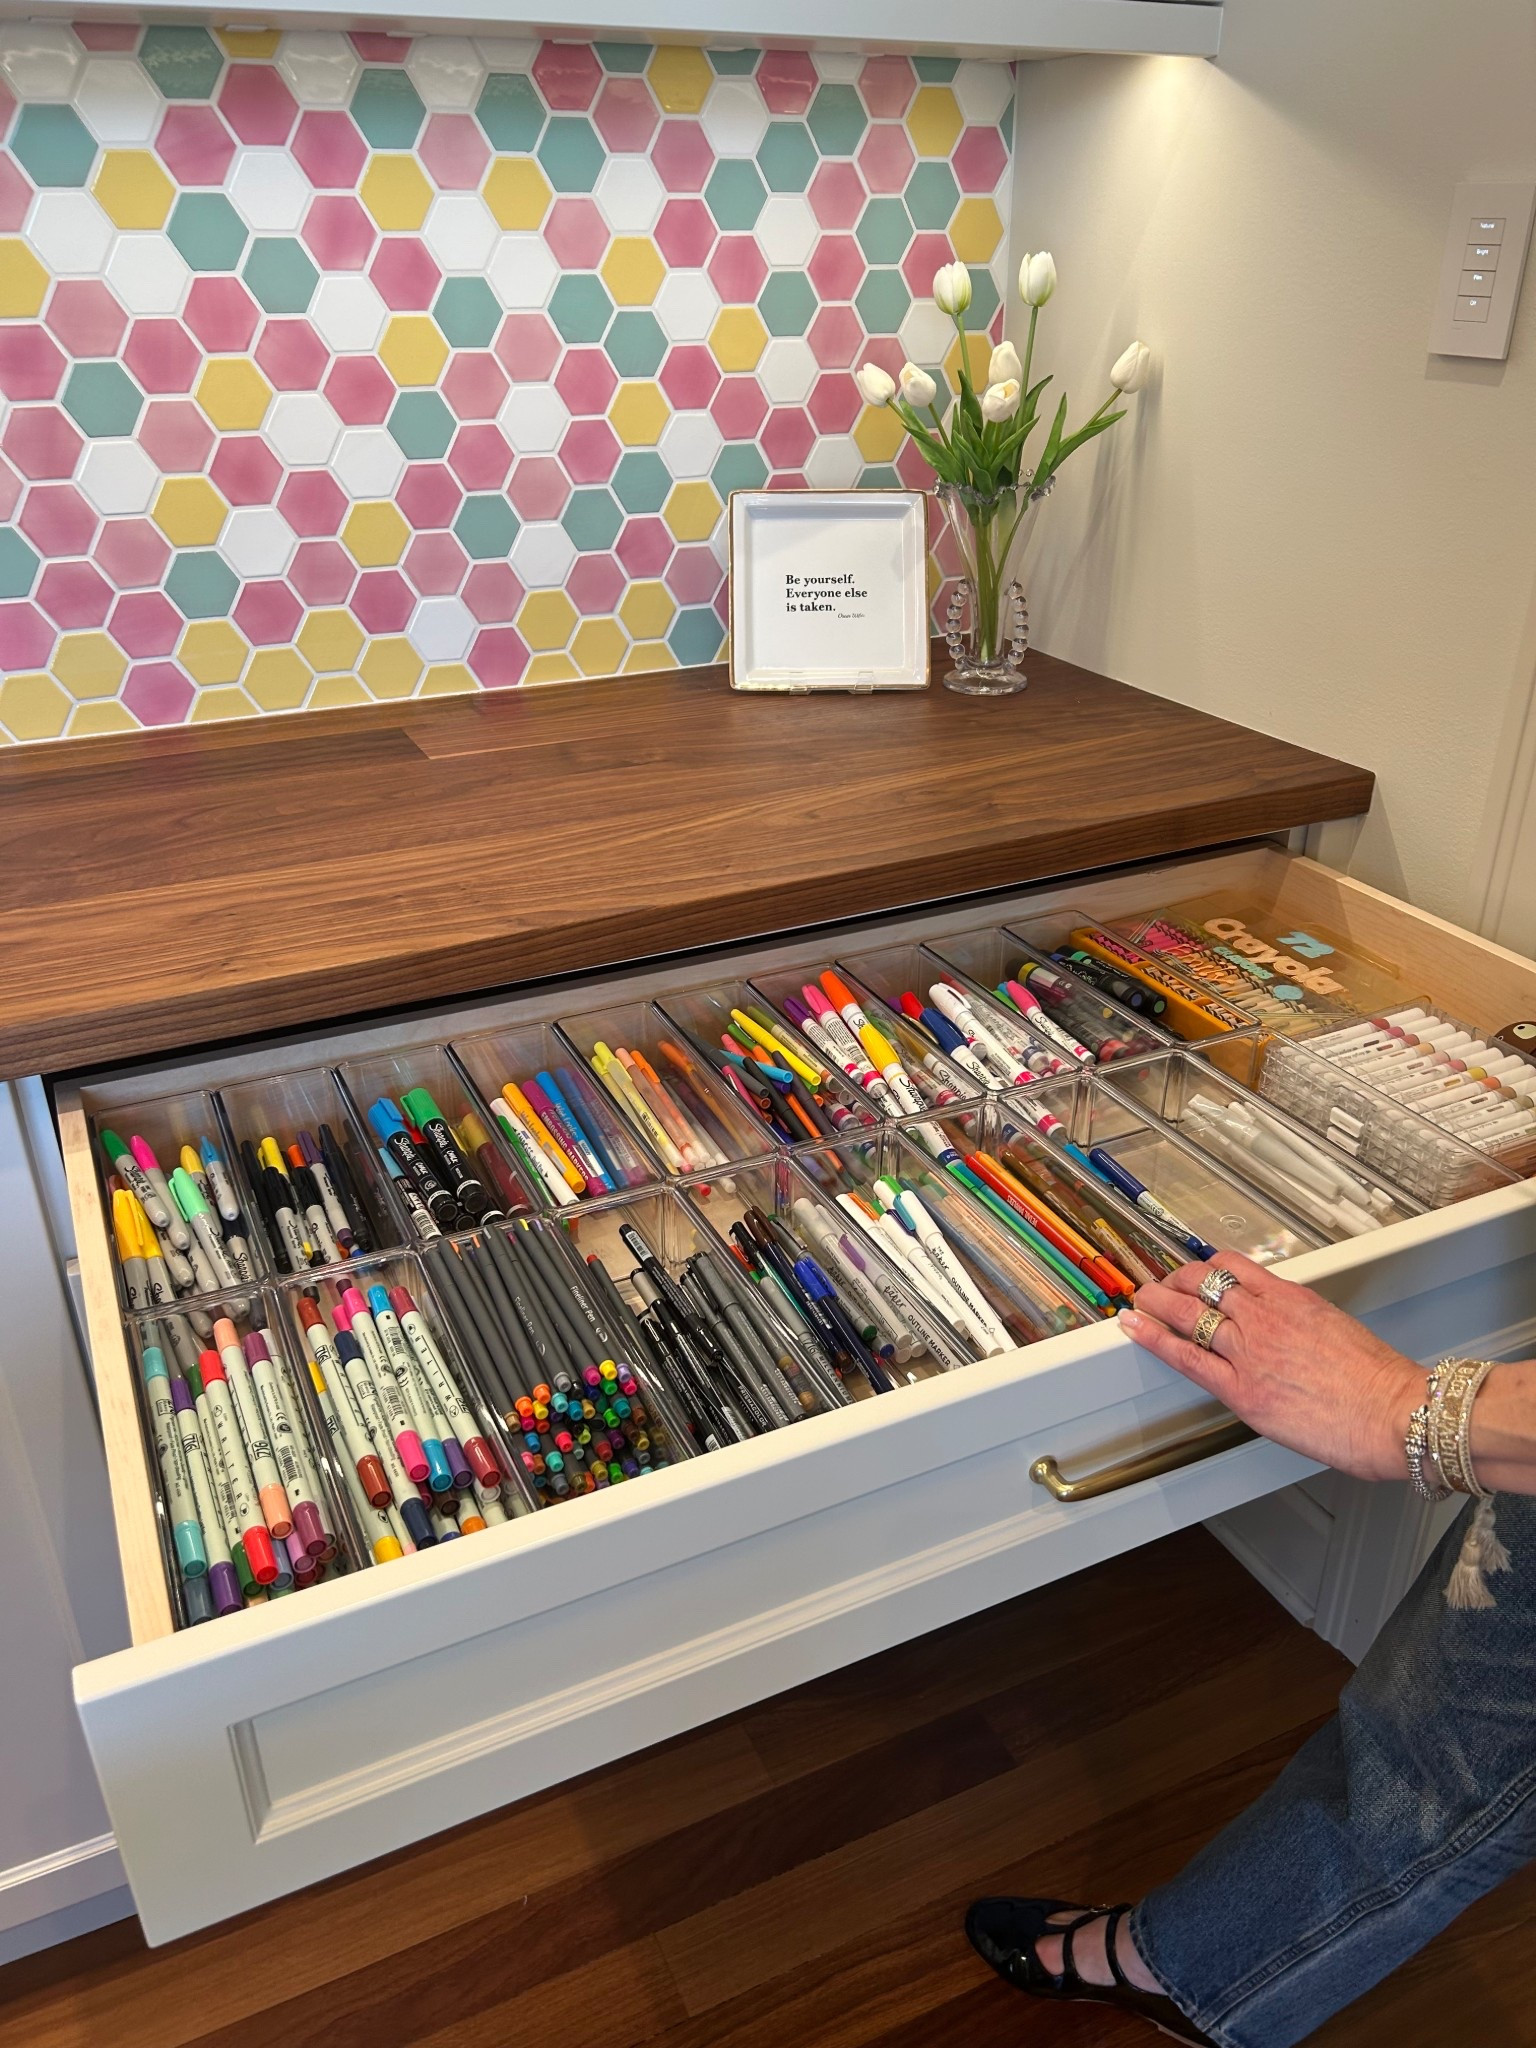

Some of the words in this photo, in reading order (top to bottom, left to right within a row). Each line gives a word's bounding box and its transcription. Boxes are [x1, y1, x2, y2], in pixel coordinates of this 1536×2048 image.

[786, 574, 801, 585] Be
[803, 574, 855, 587] yourself.
[786, 588, 842, 601] Everyone
[844, 587, 868, 598] else
[786, 602, 797, 612] is
[800, 601, 836, 612] taken.
[1203, 917, 1348, 995] Crayola
[428, 1123, 450, 1149] Sharpie
[394, 1137, 416, 1162] Sharpie
[527, 1321, 535, 1335] Pen
[585, 1310, 596, 1322] Pen
[908, 1314, 930, 1345] OUTLINE
[928, 1339, 951, 1367] MARKER
[415, 1336, 452, 1401] WRITER
[217, 1423, 242, 1500] WRITER
